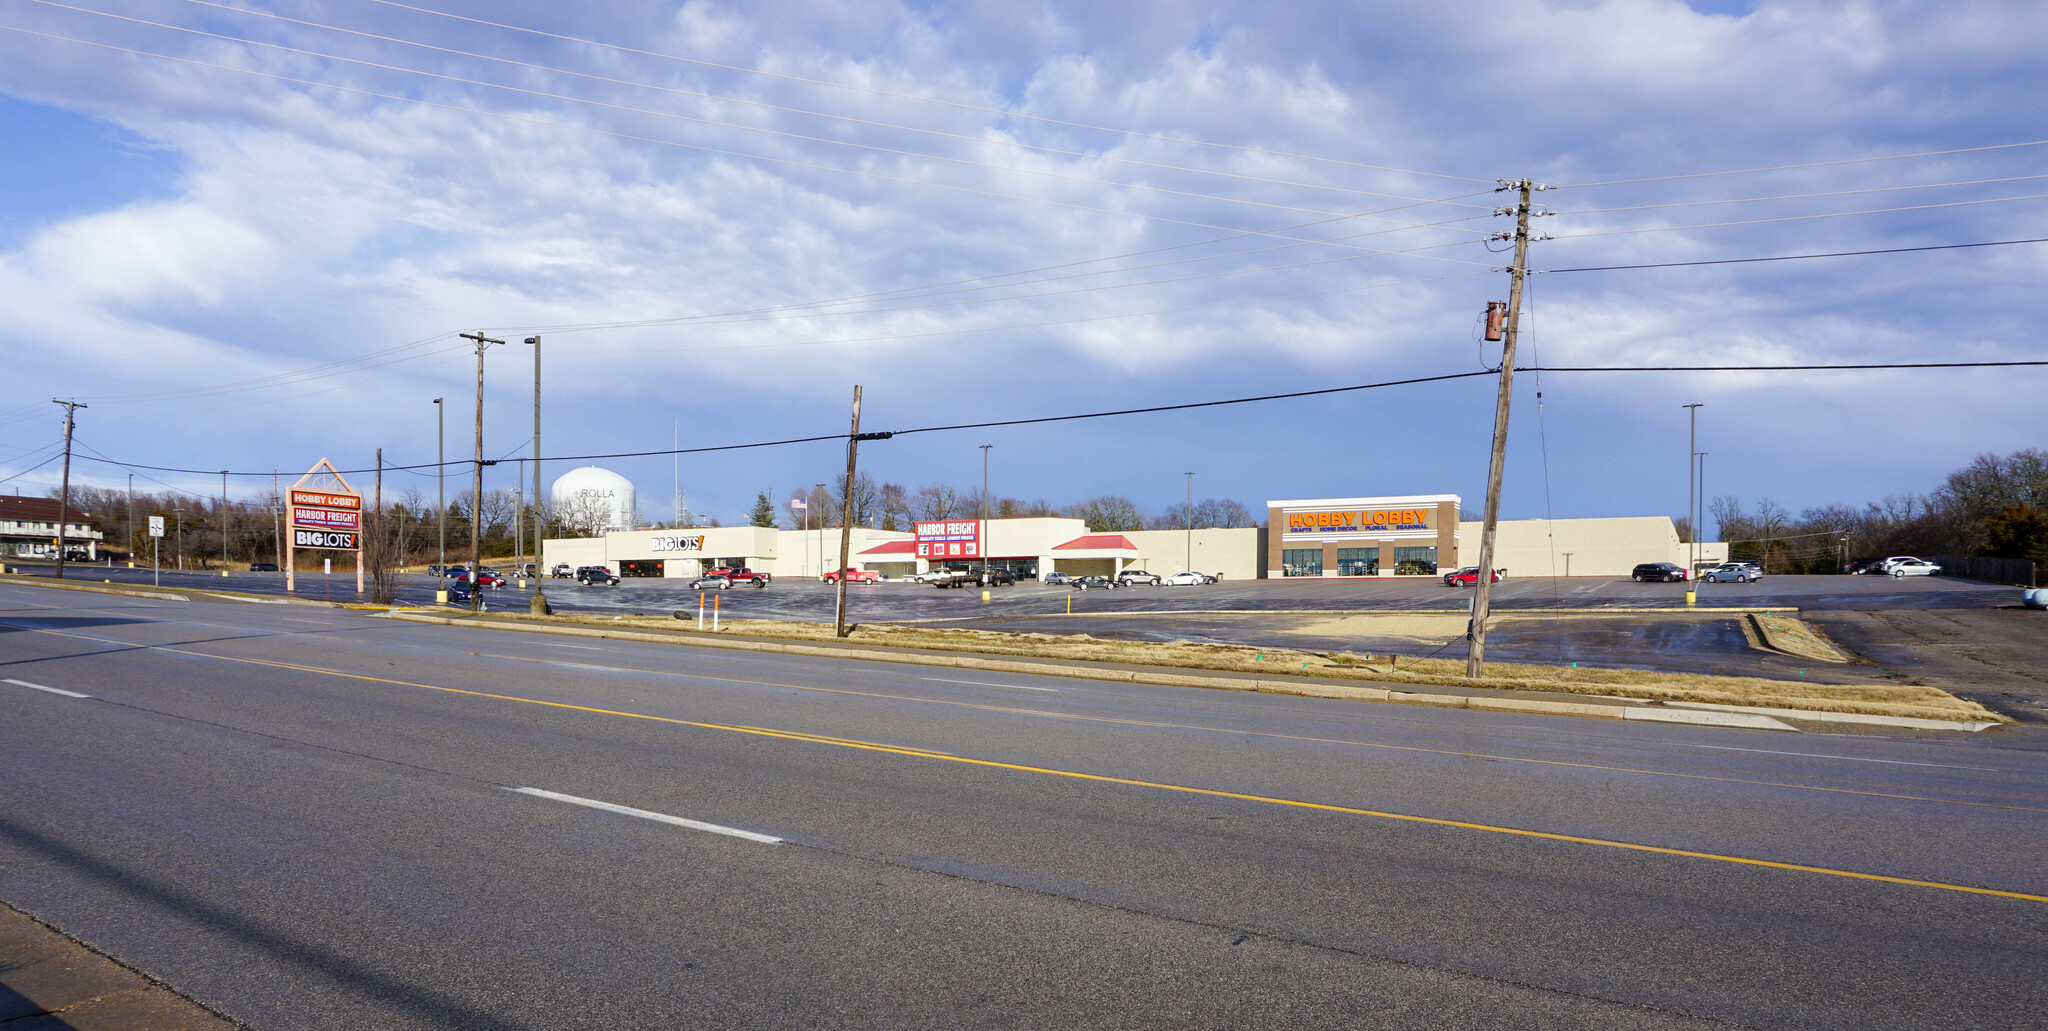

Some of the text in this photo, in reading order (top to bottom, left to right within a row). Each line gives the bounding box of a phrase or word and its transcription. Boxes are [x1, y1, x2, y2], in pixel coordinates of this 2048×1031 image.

[294, 493, 357, 506] HOBBY LOBBY
[581, 489, 614, 498] ROLLA
[296, 509, 357, 522] HARBOR FREIGHT
[1290, 509, 1428, 527] HOBBY LOBBY
[918, 522, 976, 535] HARBOR FREIGHT
